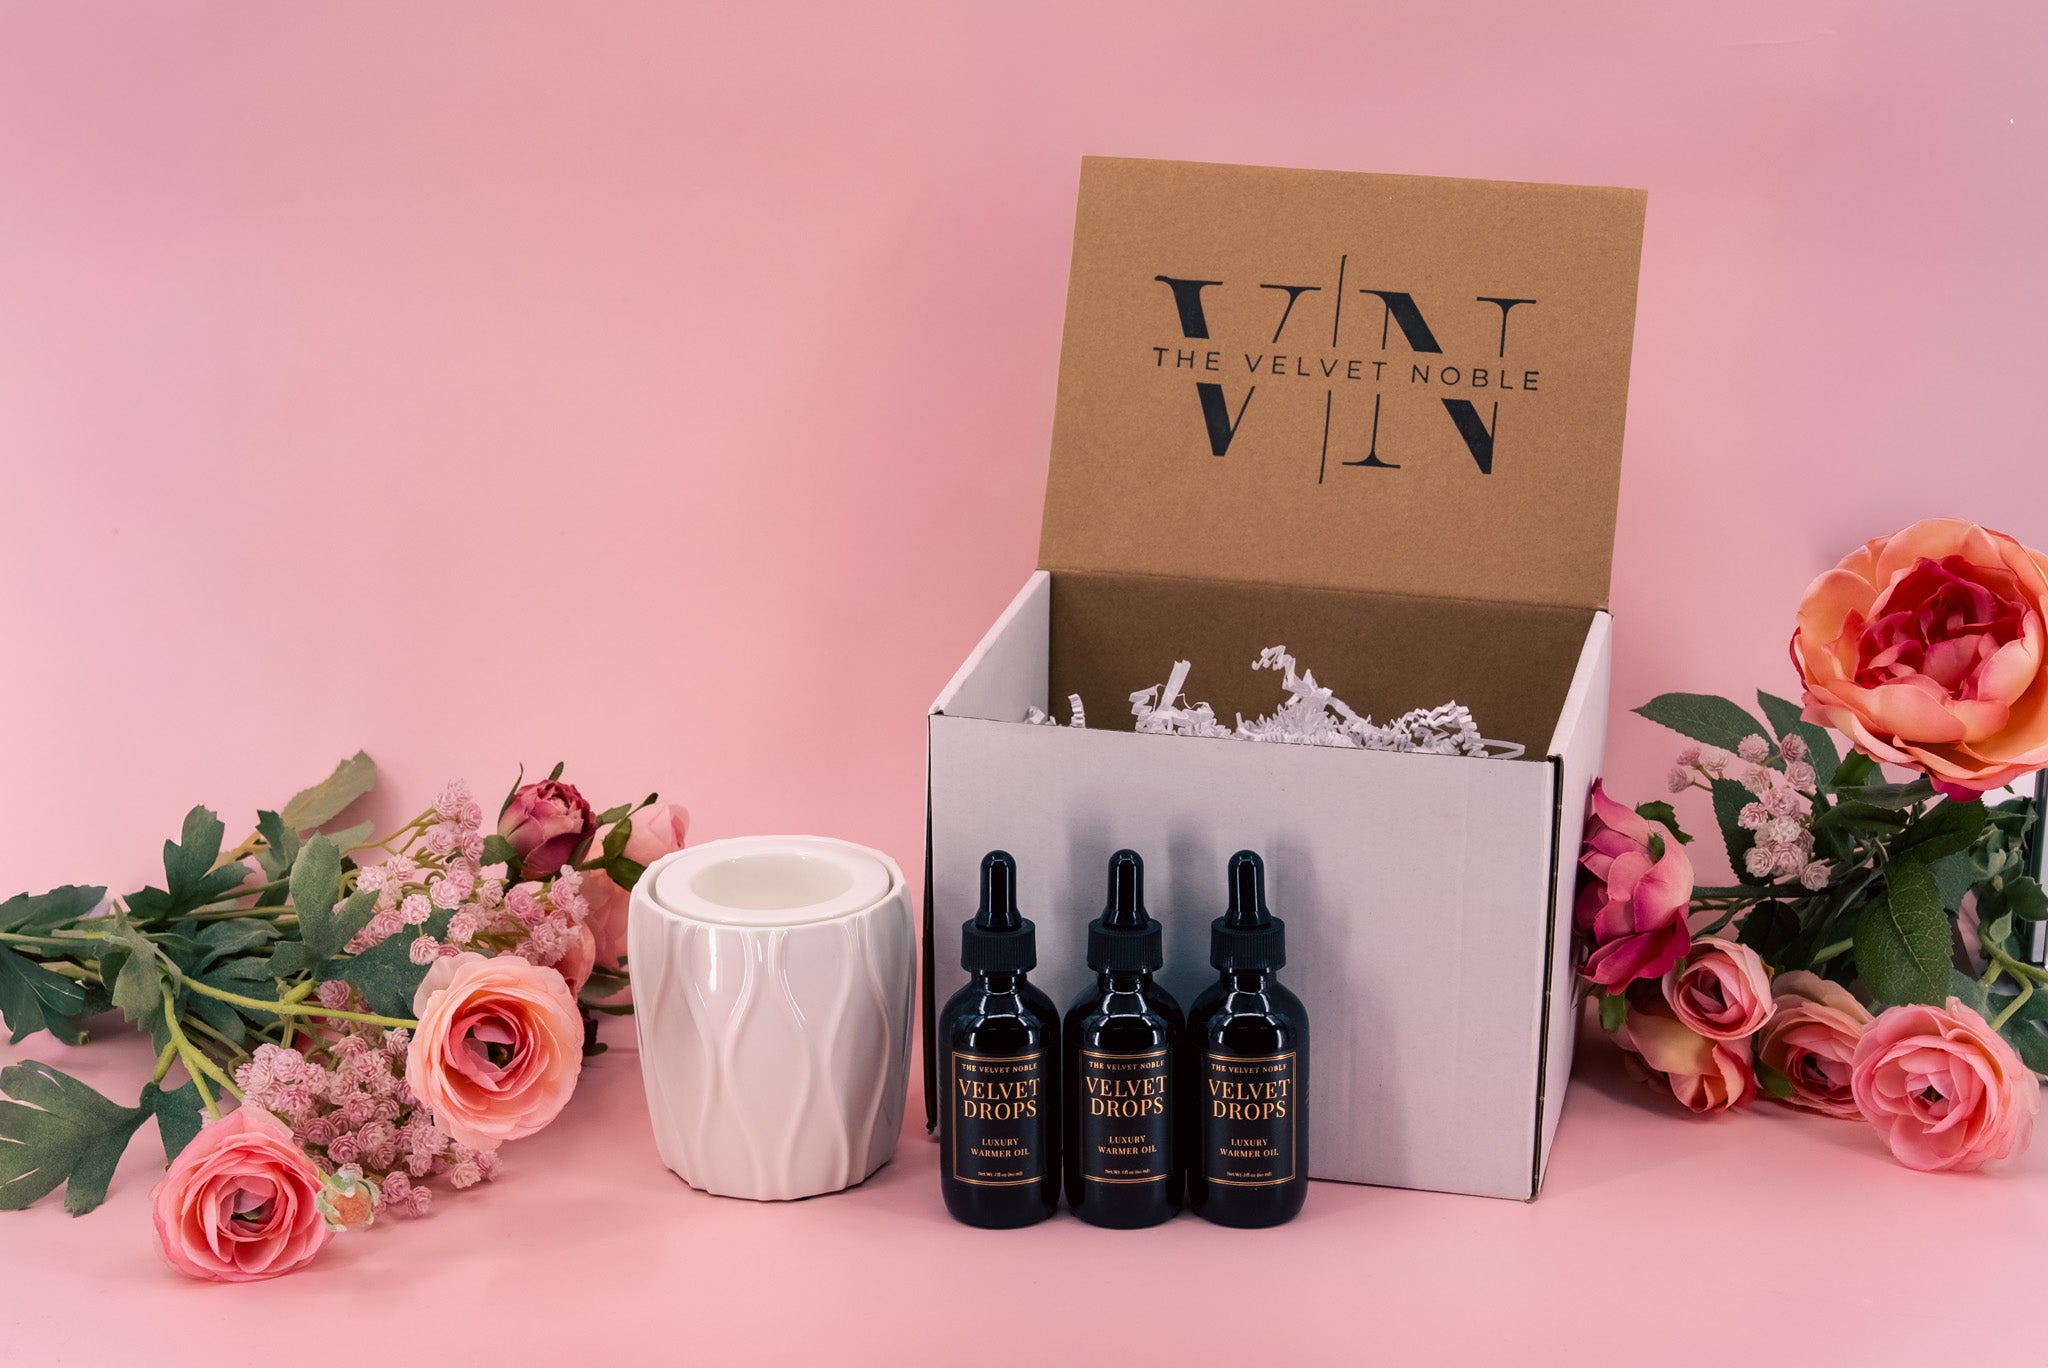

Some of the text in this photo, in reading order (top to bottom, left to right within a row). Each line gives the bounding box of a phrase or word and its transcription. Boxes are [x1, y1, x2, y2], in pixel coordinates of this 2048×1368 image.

[1152, 346, 1541, 392] THE VELVET NOBLE
[962, 1063, 1038, 1074] THE VELVET NOBLE
[1089, 1060, 1165, 1071] THE VELVET NOBLE
[1211, 1063, 1287, 1074] THE VELVET NOBLE
[958, 1079, 1041, 1100] VELVET
[1086, 1076, 1168, 1097] VELVET
[1208, 1079, 1291, 1100] VELVET
[964, 1100, 1037, 1120] DROPS
[1091, 1096, 1164, 1118] DROPS
[1213, 1100, 1286, 1120] DROPS
[982, 1138, 1019, 1147] LUXURY
[1109, 1135, 1146, 1144] LUXURY
[1231, 1138, 1268, 1147] LUXURY
[971, 1148, 1030, 1158] WARMER OIL
[1098, 1145, 1157, 1155] WARMER OIL
[1220, 1148, 1279, 1158] WARMER OIL
